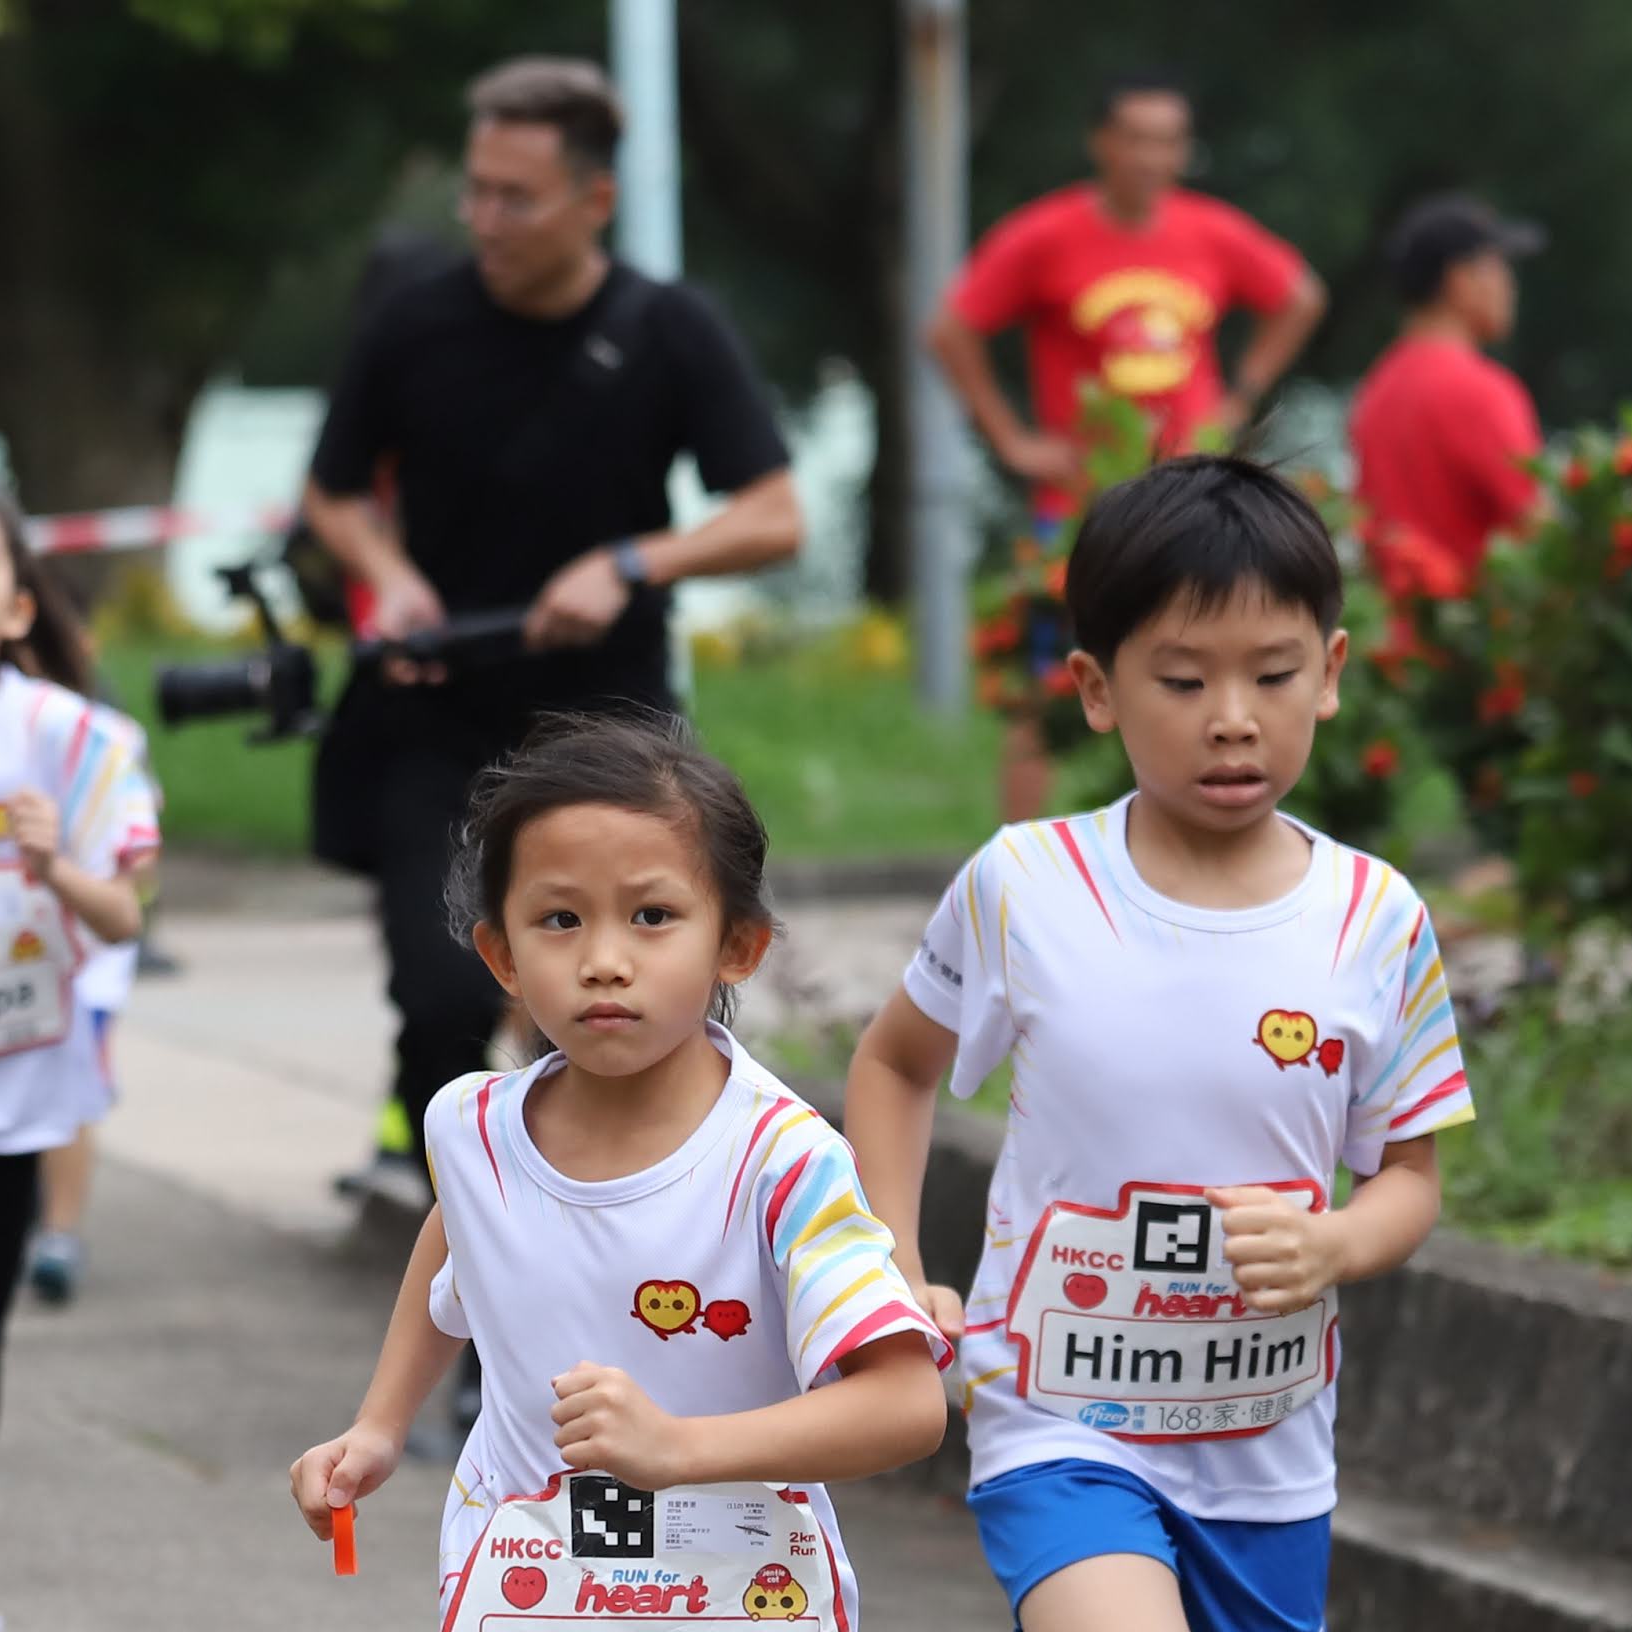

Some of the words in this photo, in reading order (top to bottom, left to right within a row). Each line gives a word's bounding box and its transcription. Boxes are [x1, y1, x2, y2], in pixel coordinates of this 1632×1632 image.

[1051, 1244, 1125, 1272] HKCC
[1133, 1280, 1248, 1319] heart
[1167, 1281, 1201, 1294] RUN
[1205, 1283, 1229, 1295] for
[1064, 1332, 1183, 1383] Him
[1204, 1333, 1306, 1383] Him
[1081, 1404, 1129, 1428] Pfizer
[490, 1537, 563, 1560] HKCC
[790, 1545, 817, 1556] Run
[612, 1569, 648, 1583] RUN
[654, 1569, 680, 1583] for
[574, 1569, 709, 1614] heart
